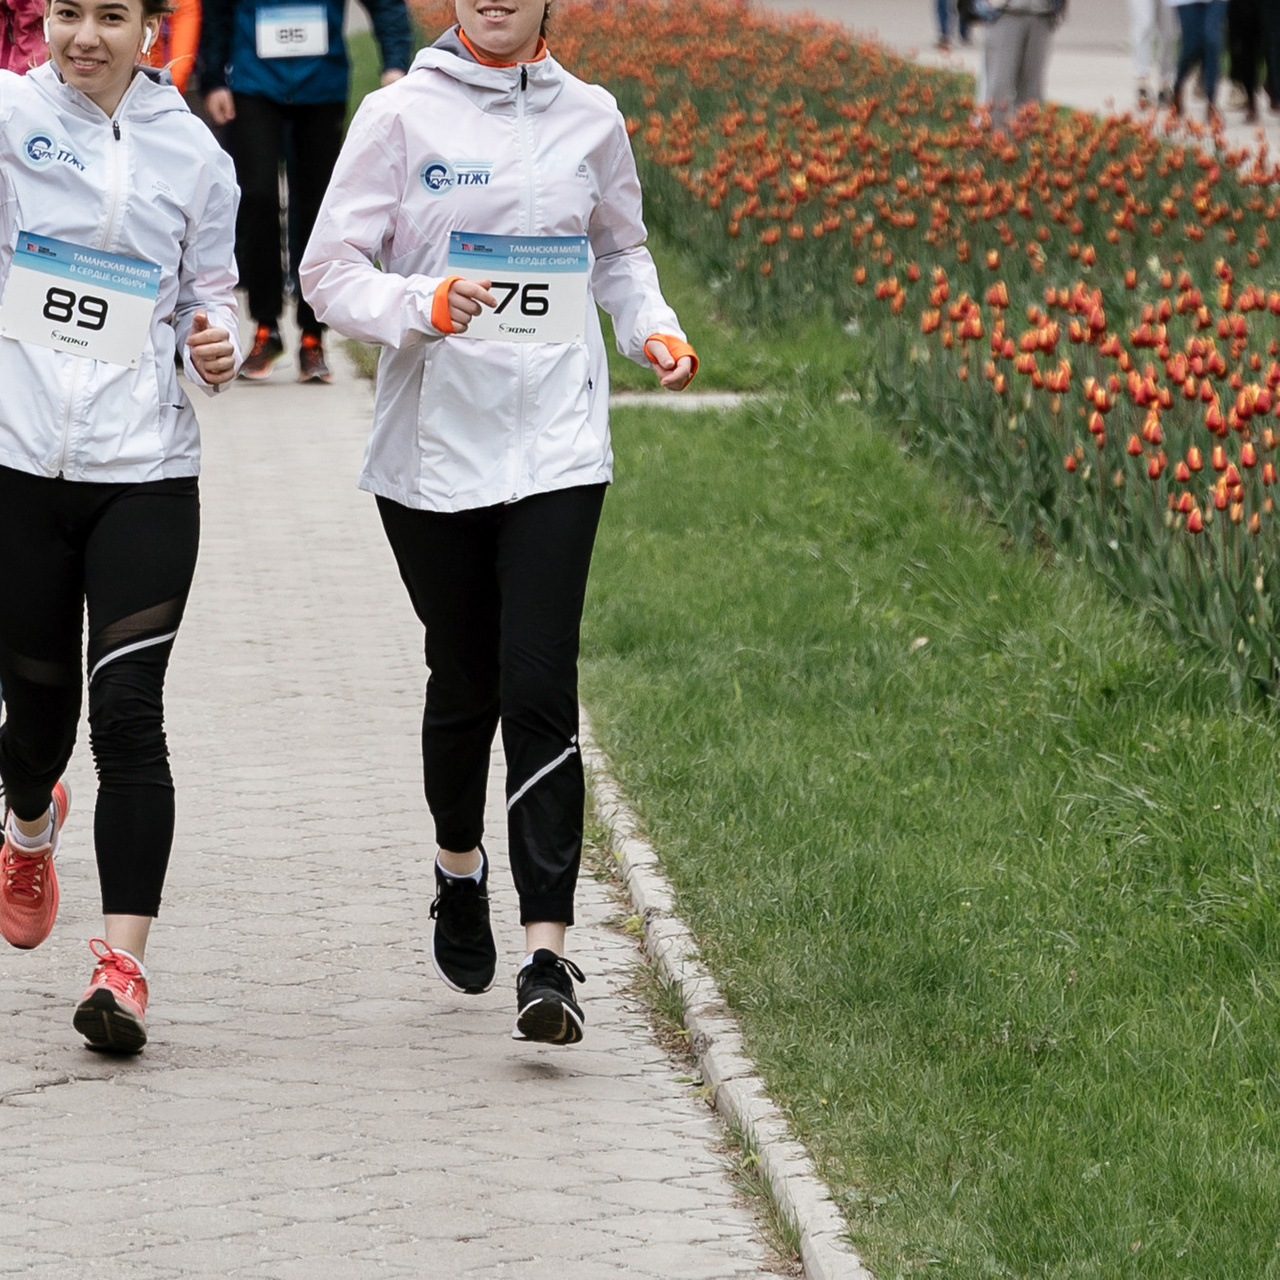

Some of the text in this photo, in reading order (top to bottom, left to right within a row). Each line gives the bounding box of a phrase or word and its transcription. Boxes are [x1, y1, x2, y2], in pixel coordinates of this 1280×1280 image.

[507, 256, 579, 266] В СЕРДЦЕ СИБИРИ
[509, 244, 581, 254] ТАМАНСКАЯ МИЛЯ
[69, 264, 147, 289] В СЕРДЦЕ СИБИРИ
[73, 252, 151, 279] ТАМАНСКАЯ МИЛЯ
[43, 286, 109, 331] 89
[490, 281, 550, 316] 76
